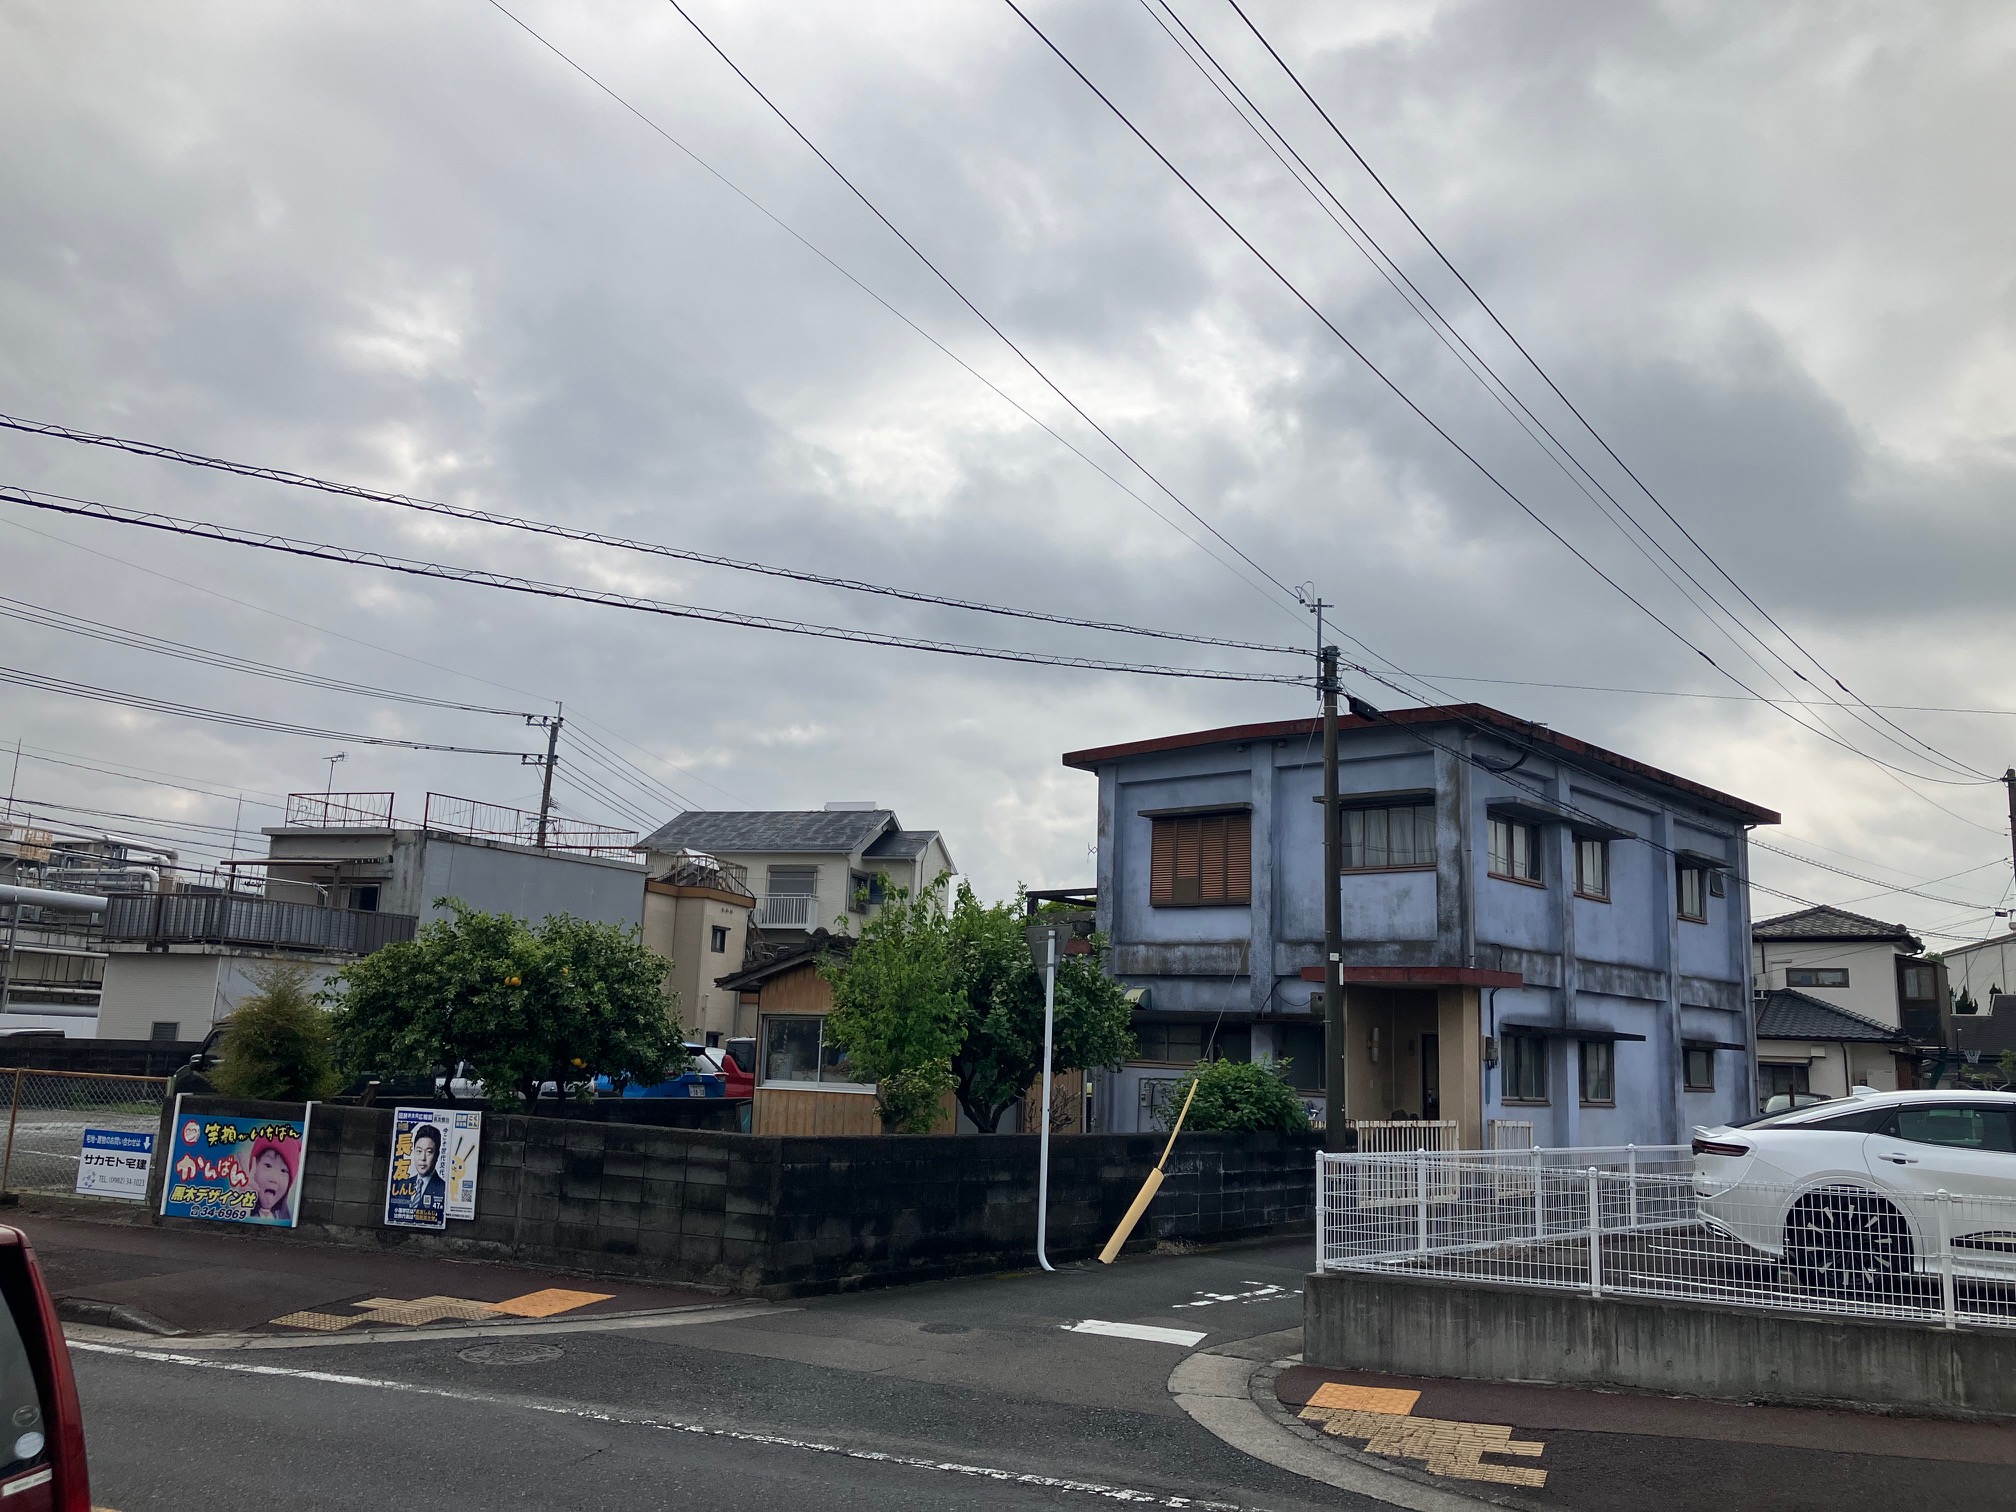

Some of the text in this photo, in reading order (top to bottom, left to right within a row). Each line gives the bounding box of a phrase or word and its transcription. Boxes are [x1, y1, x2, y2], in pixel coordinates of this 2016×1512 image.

[204, 1122, 302, 1147] 笑顔がいちばん
[84, 1154, 147, 1170] サカモト宅建
[393, 1133, 413, 1180] 長友
[99, 1175, 107, 1183] TEL
[176, 1154, 248, 1187] かんばん
[171, 1185, 257, 1208] 黒木デザイン社
[391, 1183, 416, 1195] しんじ
[200, 1207, 247, 1220] 34-6969
